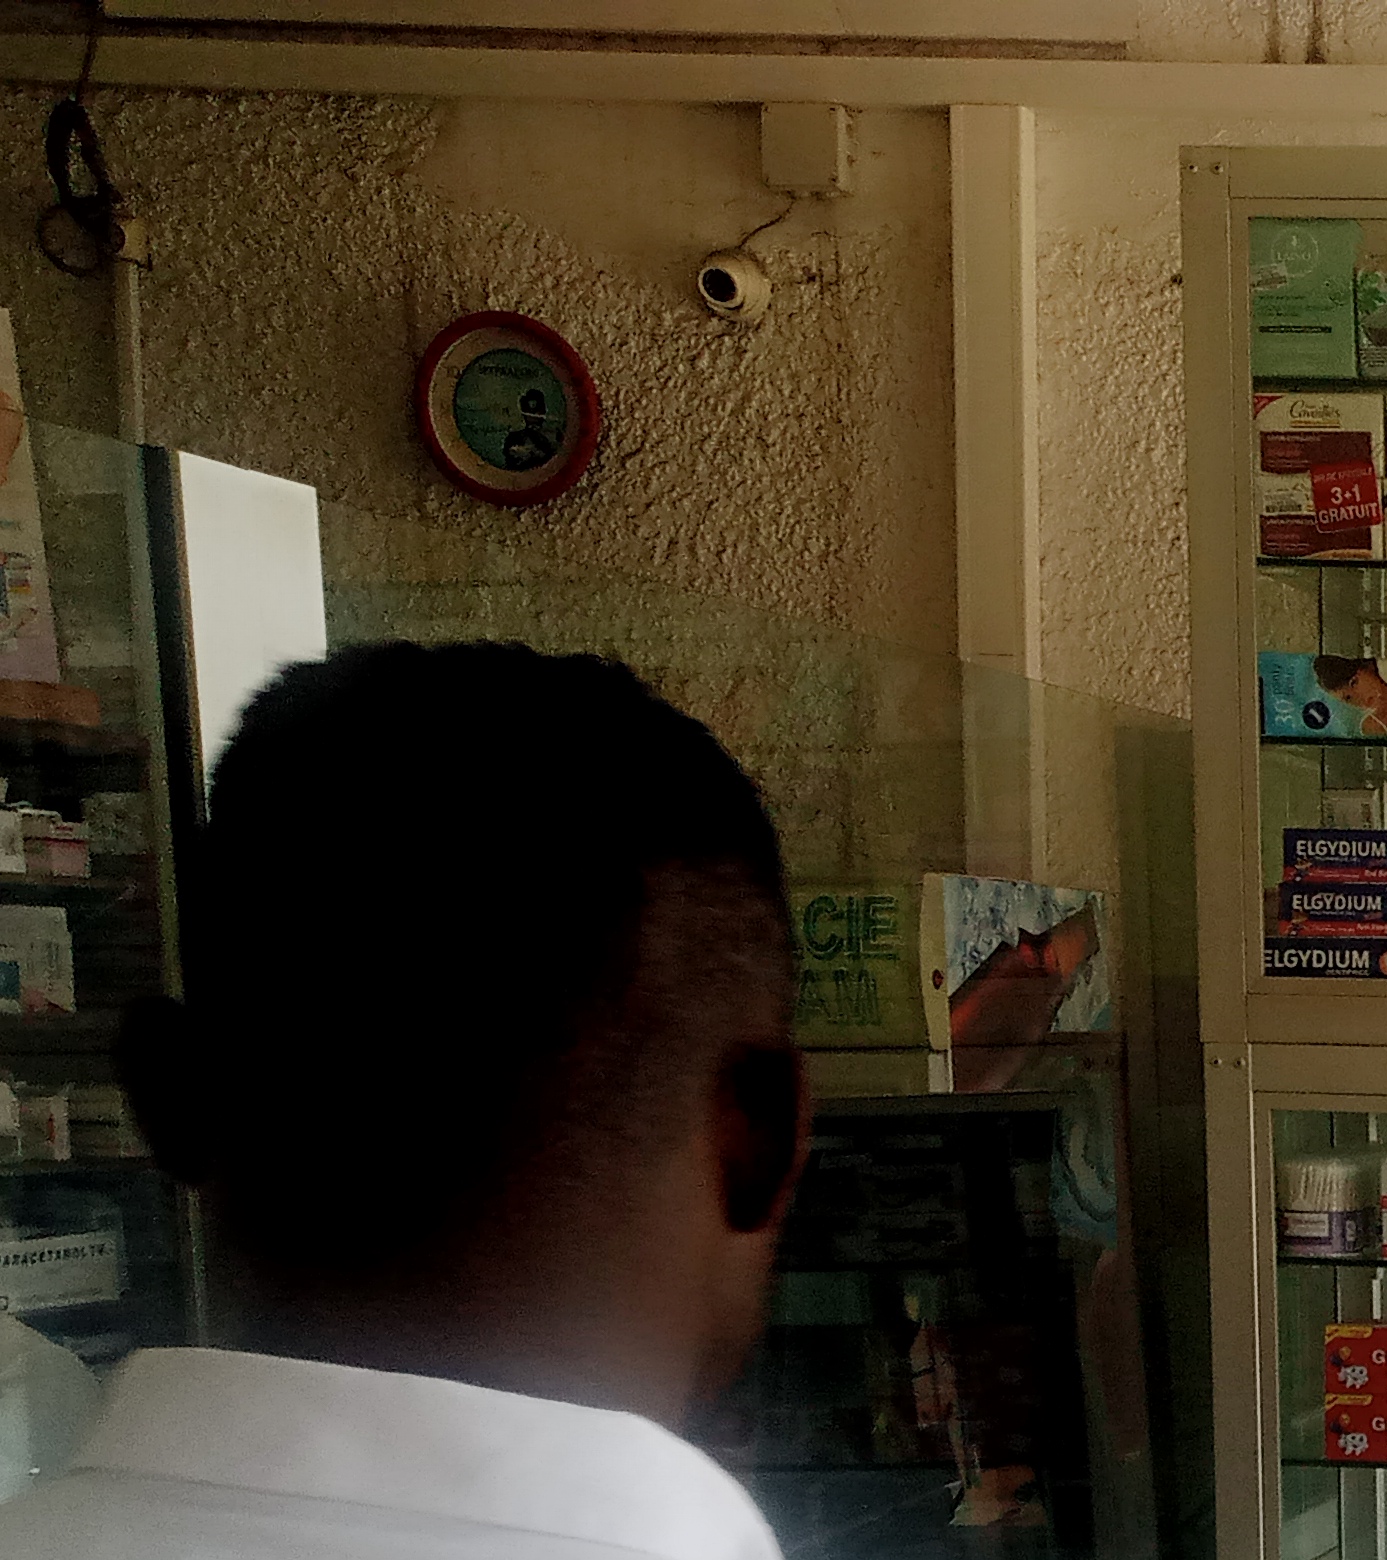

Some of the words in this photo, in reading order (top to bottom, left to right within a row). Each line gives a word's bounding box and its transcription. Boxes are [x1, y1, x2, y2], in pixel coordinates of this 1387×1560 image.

[1331, 484, 1360, 504] 3+1
[1319, 502, 1377, 524] GRATUIT
[1296, 840, 1386, 857] ELGYDIUM
[1292, 893, 1382, 912] ELGYDIUM
[1264, 950, 1370, 968] ELGYDIUM
